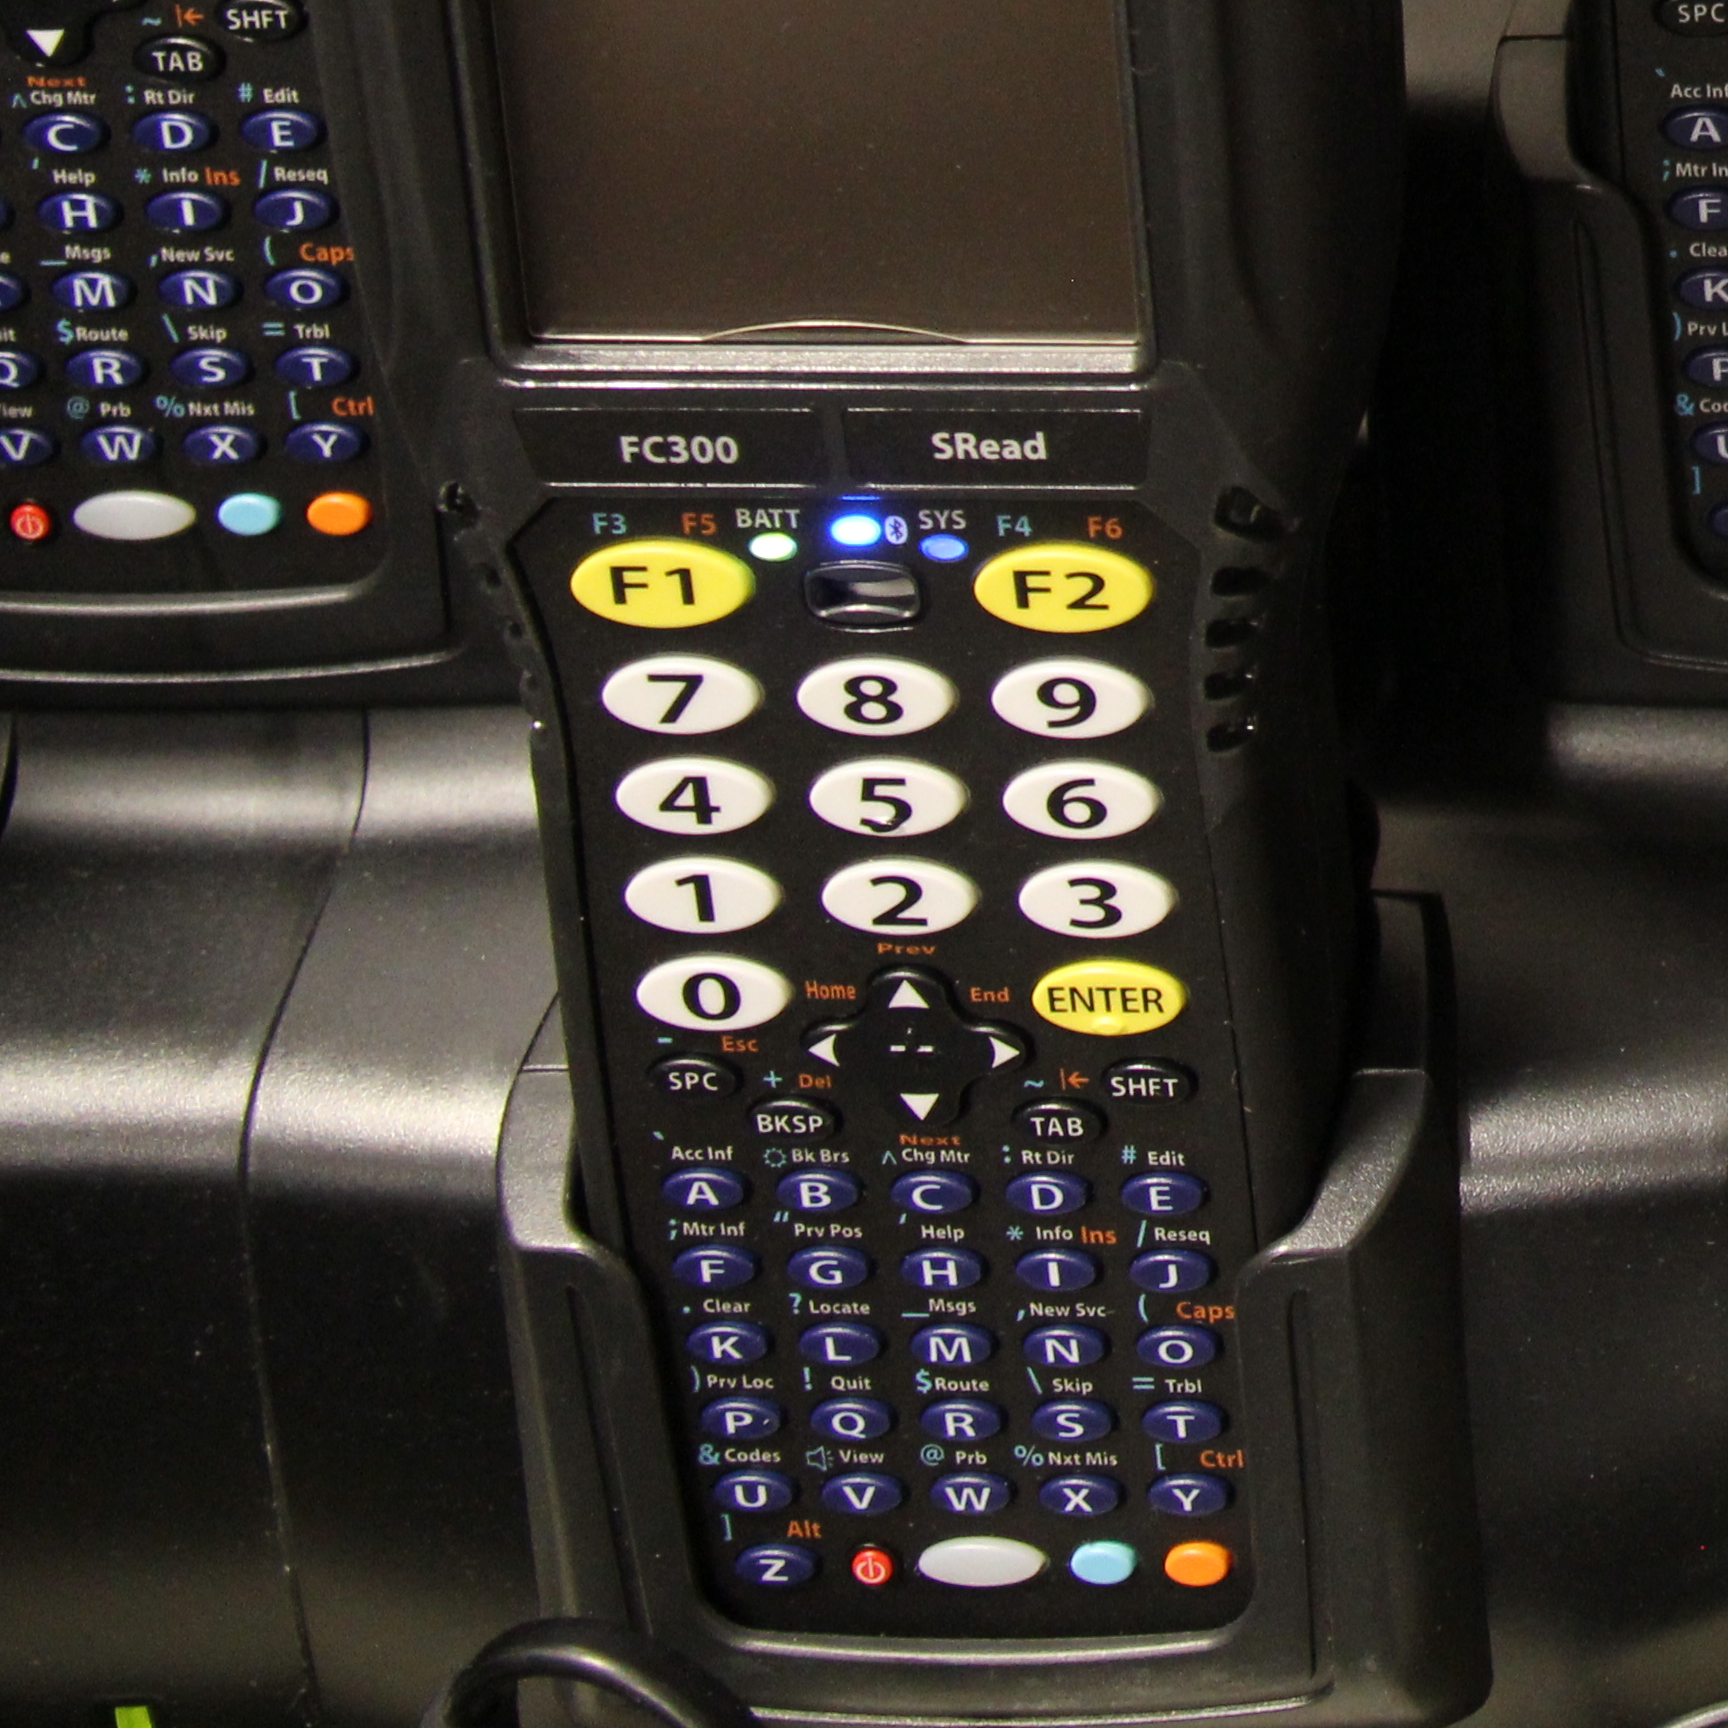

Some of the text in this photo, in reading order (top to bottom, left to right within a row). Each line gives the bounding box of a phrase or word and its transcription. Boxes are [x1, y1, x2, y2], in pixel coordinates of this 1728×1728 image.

[226, 8, 288, 30] SHFT
[1677, 2, 1725, 23] SPC
[151, 51, 203, 72] TAB
[263, 88, 298, 103] Edit
[273, 166, 329, 185] Reseq
[75, 326, 128, 341] Route
[332, 396, 374, 416] Ctrl
[620, 435, 739, 464] FC300
[931, 431, 1047, 460] SRead
[592, 513, 627, 535] F3
[682, 513, 716, 535] F5
[735, 508, 800, 529] BATT
[917, 509, 966, 530] SYS
[997, 515, 1032, 537] F4
[1088, 516, 1123, 539] F6
[609, 565, 695, 606] F1
[1012, 569, 1110, 611] F2
[647, 673, 704, 724] 7
[843, 674, 904, 725] 8
[1036, 676, 1097, 729] 9
[659, 775, 721, 825] 4
[860, 777, 913, 834] 5
[1046, 778, 1108, 830] 6
[675, 873, 716, 923] 1
[870, 874, 929, 927] 2
[1067, 876, 1123, 930] 3
[682, 971, 742, 1021] 0
[805, 981, 856, 1000] Home
[970, 987, 1010, 1003] End
[1047, 986, 1164, 1013] ENTER
[667, 1071, 718, 1092] SPC
[1110, 1076, 1178, 1097] SHFT
[756, 1113, 823, 1134] BKSP
[1030, 1116, 1084, 1137] TAB
[1147, 1151, 1184, 1166] Edit
[1035, 1225, 1073, 1241] Info
[830, 1375, 871, 1391] Quit
[1052, 1377, 1093, 1396] Skip
[724, 1448, 781, 1463] Codes
